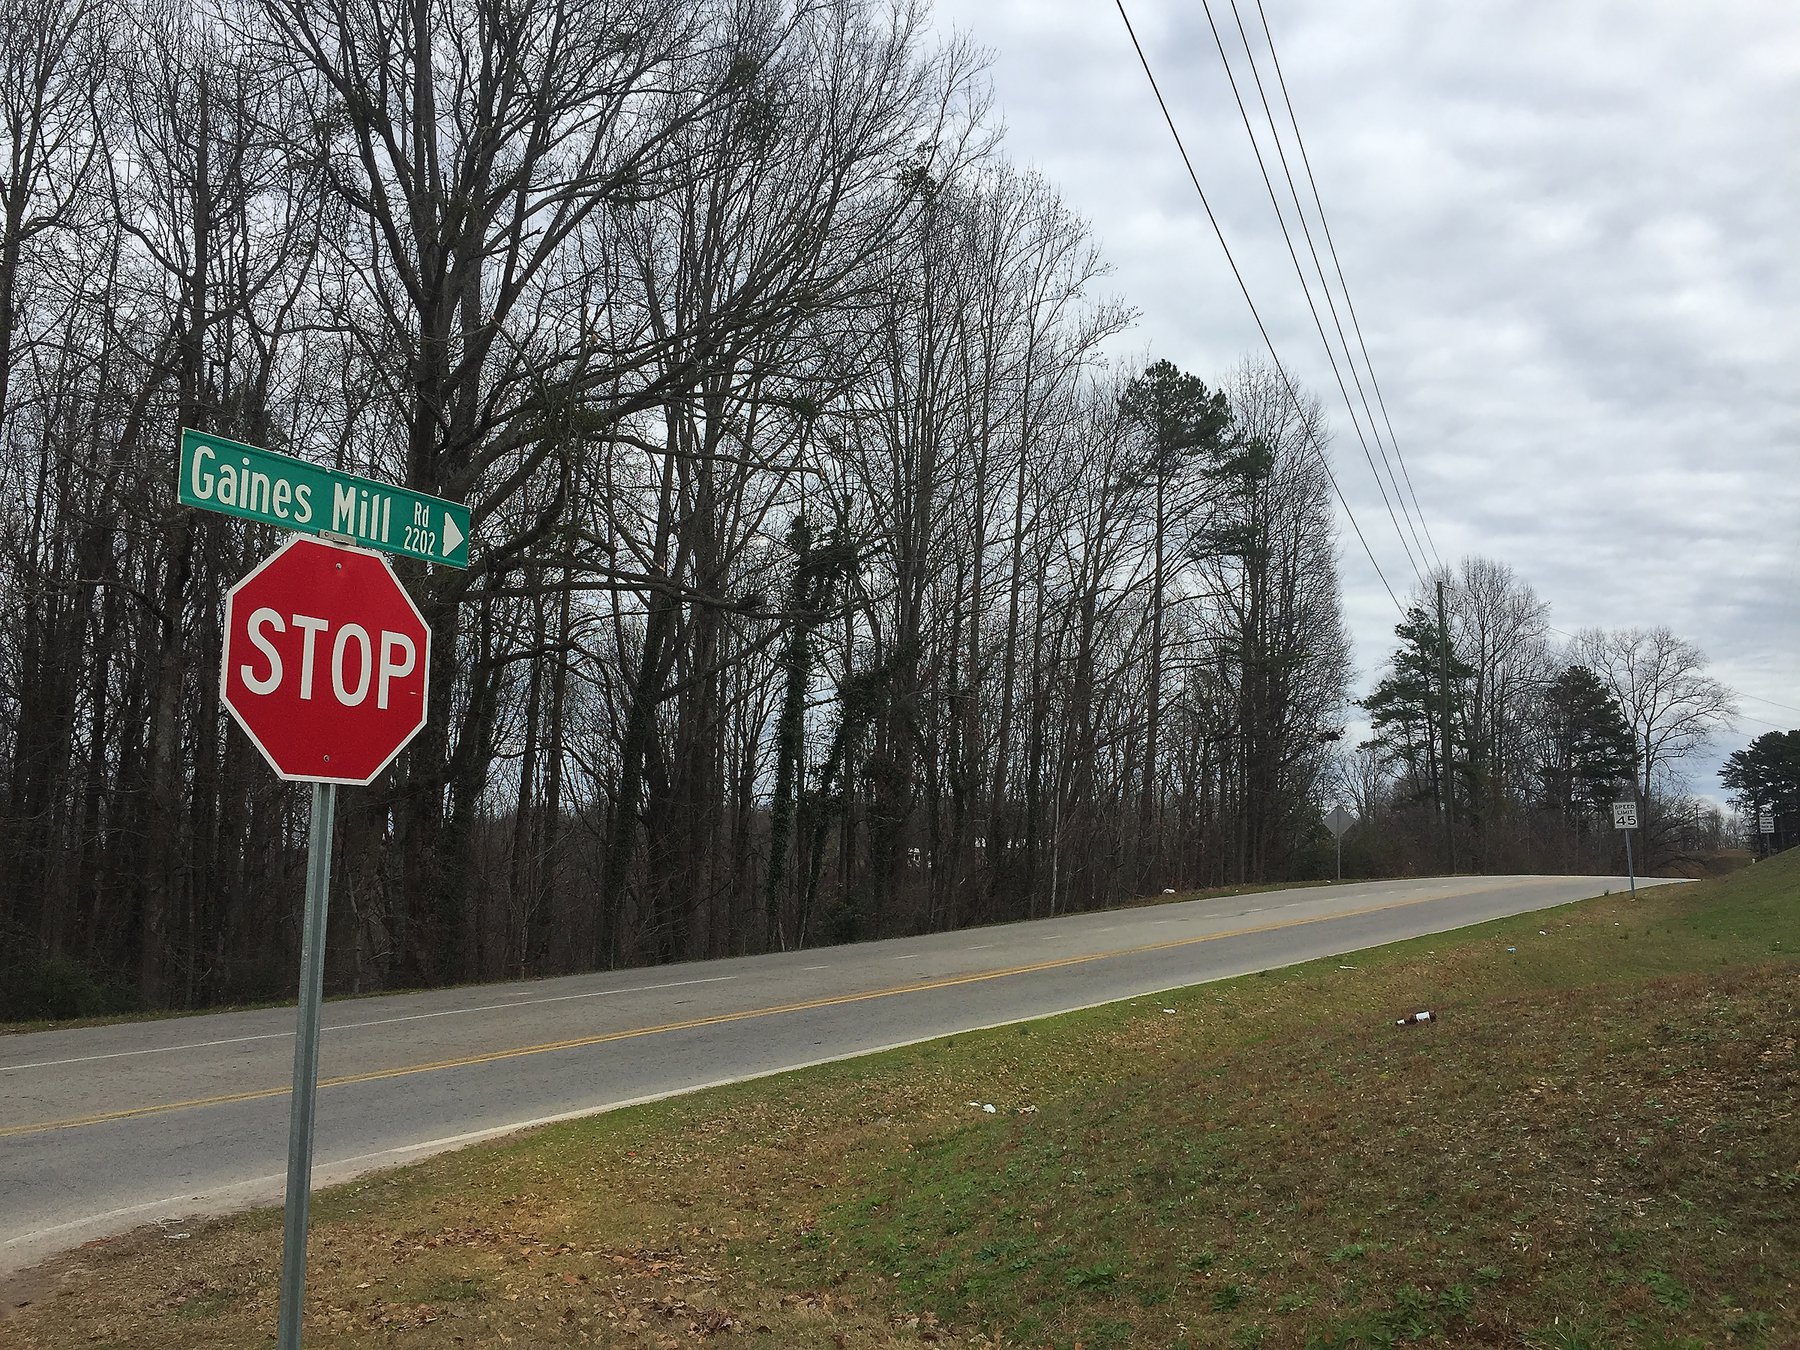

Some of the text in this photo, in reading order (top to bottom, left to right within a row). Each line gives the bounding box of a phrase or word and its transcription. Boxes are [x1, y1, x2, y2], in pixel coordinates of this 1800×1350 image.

[192, 445, 391, 543] Gaines Mill
[414, 501, 430, 528] Rd
[403, 525, 436, 556] 2202
[240, 607, 416, 710] STOP
[1616, 815, 1637, 825] 45
